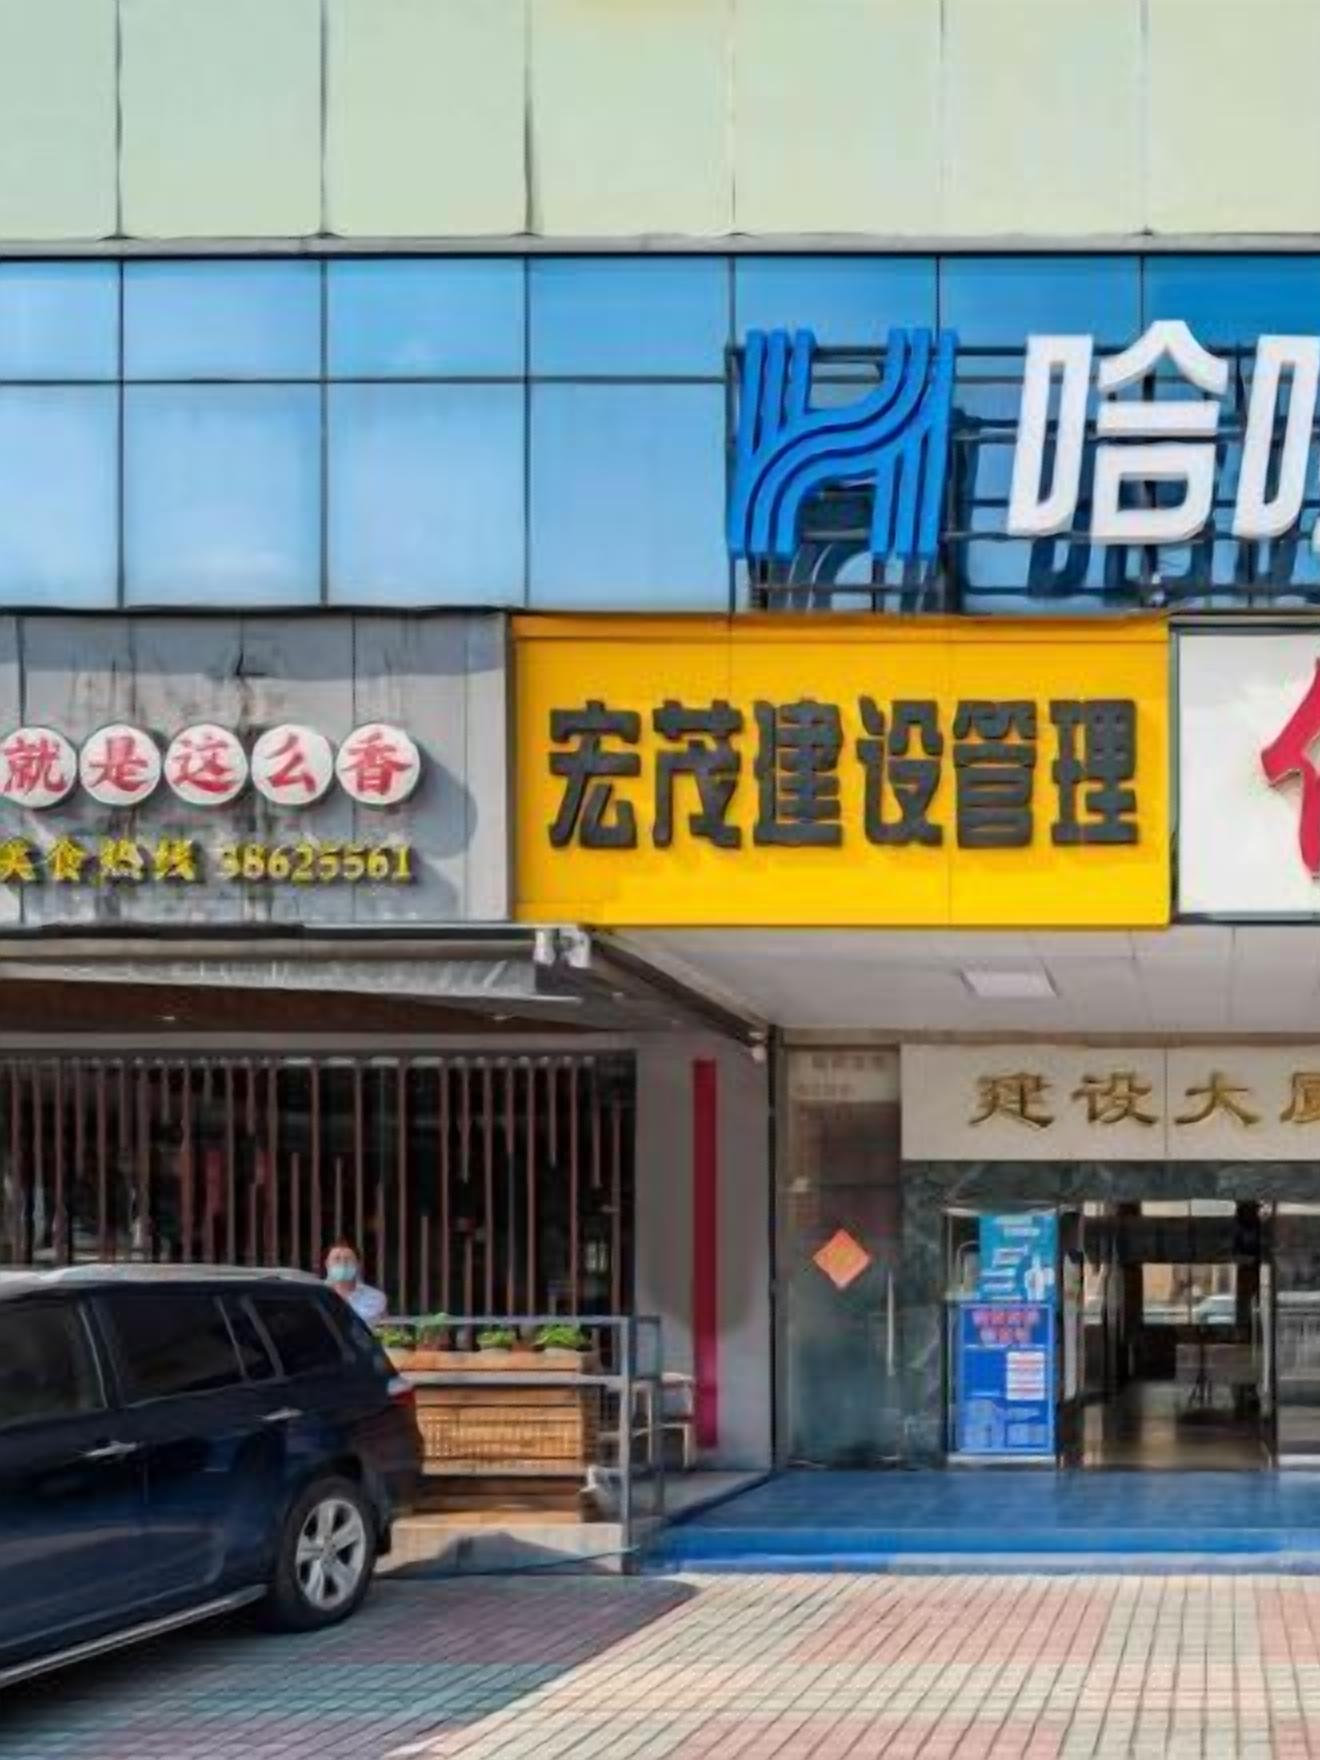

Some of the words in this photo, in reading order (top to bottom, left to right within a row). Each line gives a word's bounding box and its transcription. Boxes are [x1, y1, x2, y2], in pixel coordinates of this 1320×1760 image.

[1, 730, 412, 798] 就是这么香
[548, 696, 1140, 850] 宏茂建设管理
